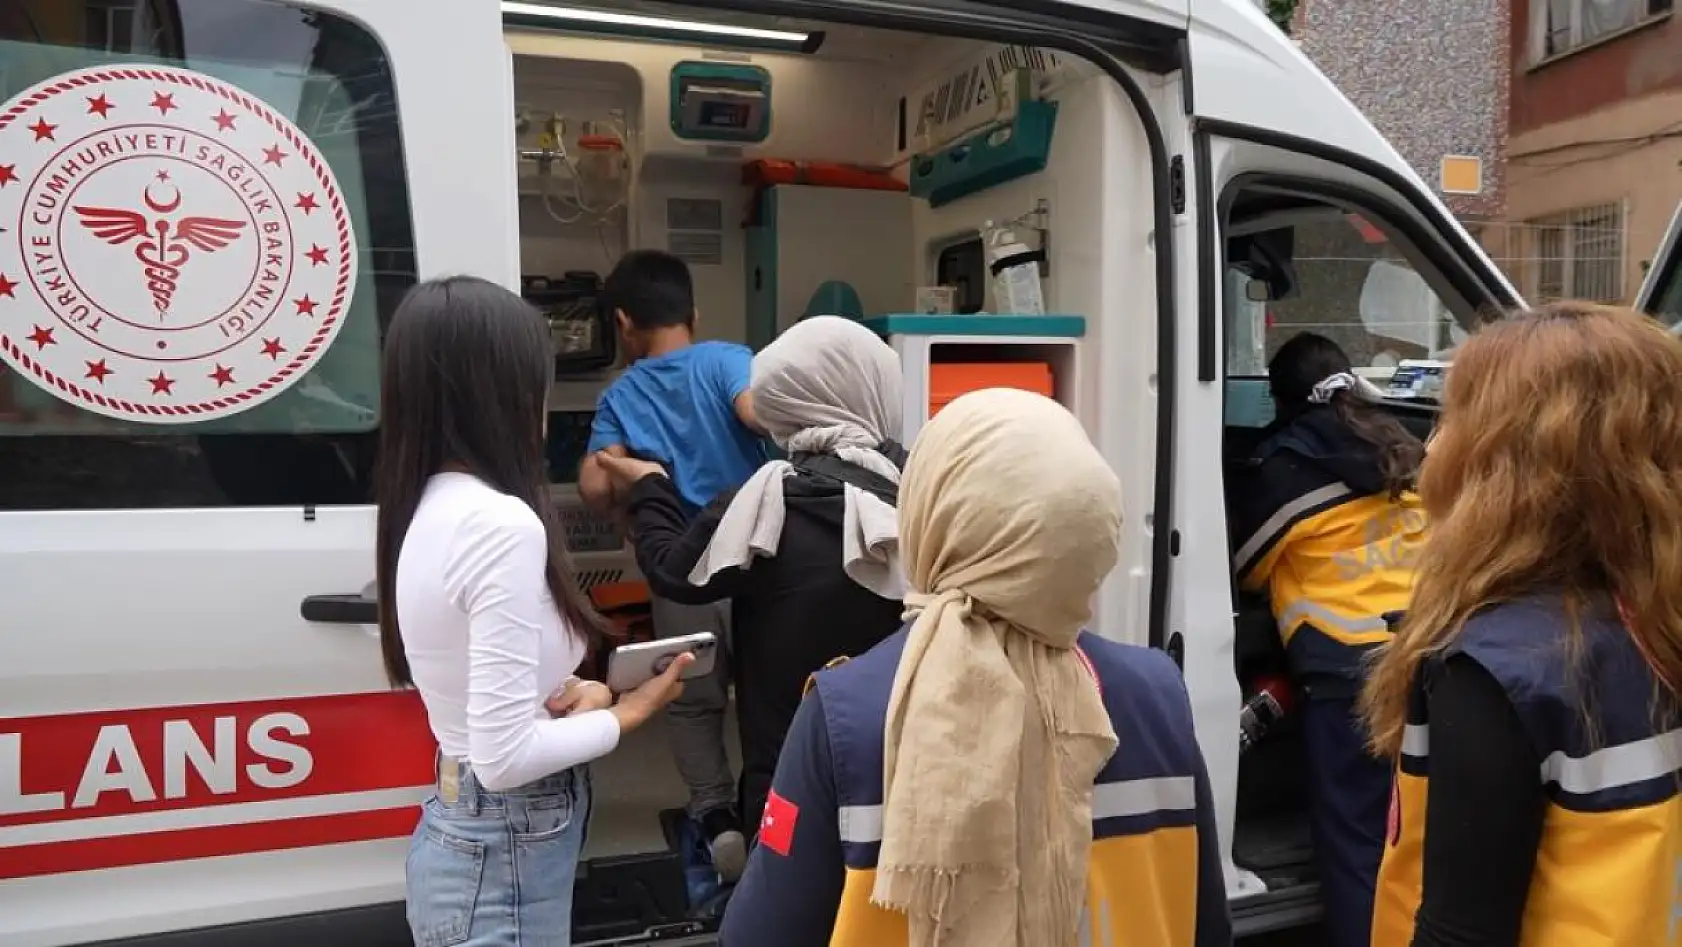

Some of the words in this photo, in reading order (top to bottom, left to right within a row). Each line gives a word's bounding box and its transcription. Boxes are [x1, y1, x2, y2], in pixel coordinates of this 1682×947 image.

[32, 133, 186, 225] CUMHURİYETİ
[195, 145, 271, 214] SAĞLIK
[31, 235, 102, 332] TÜRKİYE
[218, 221, 283, 338] BAKANLIĞI
[0, 711, 314, 815] LANS
